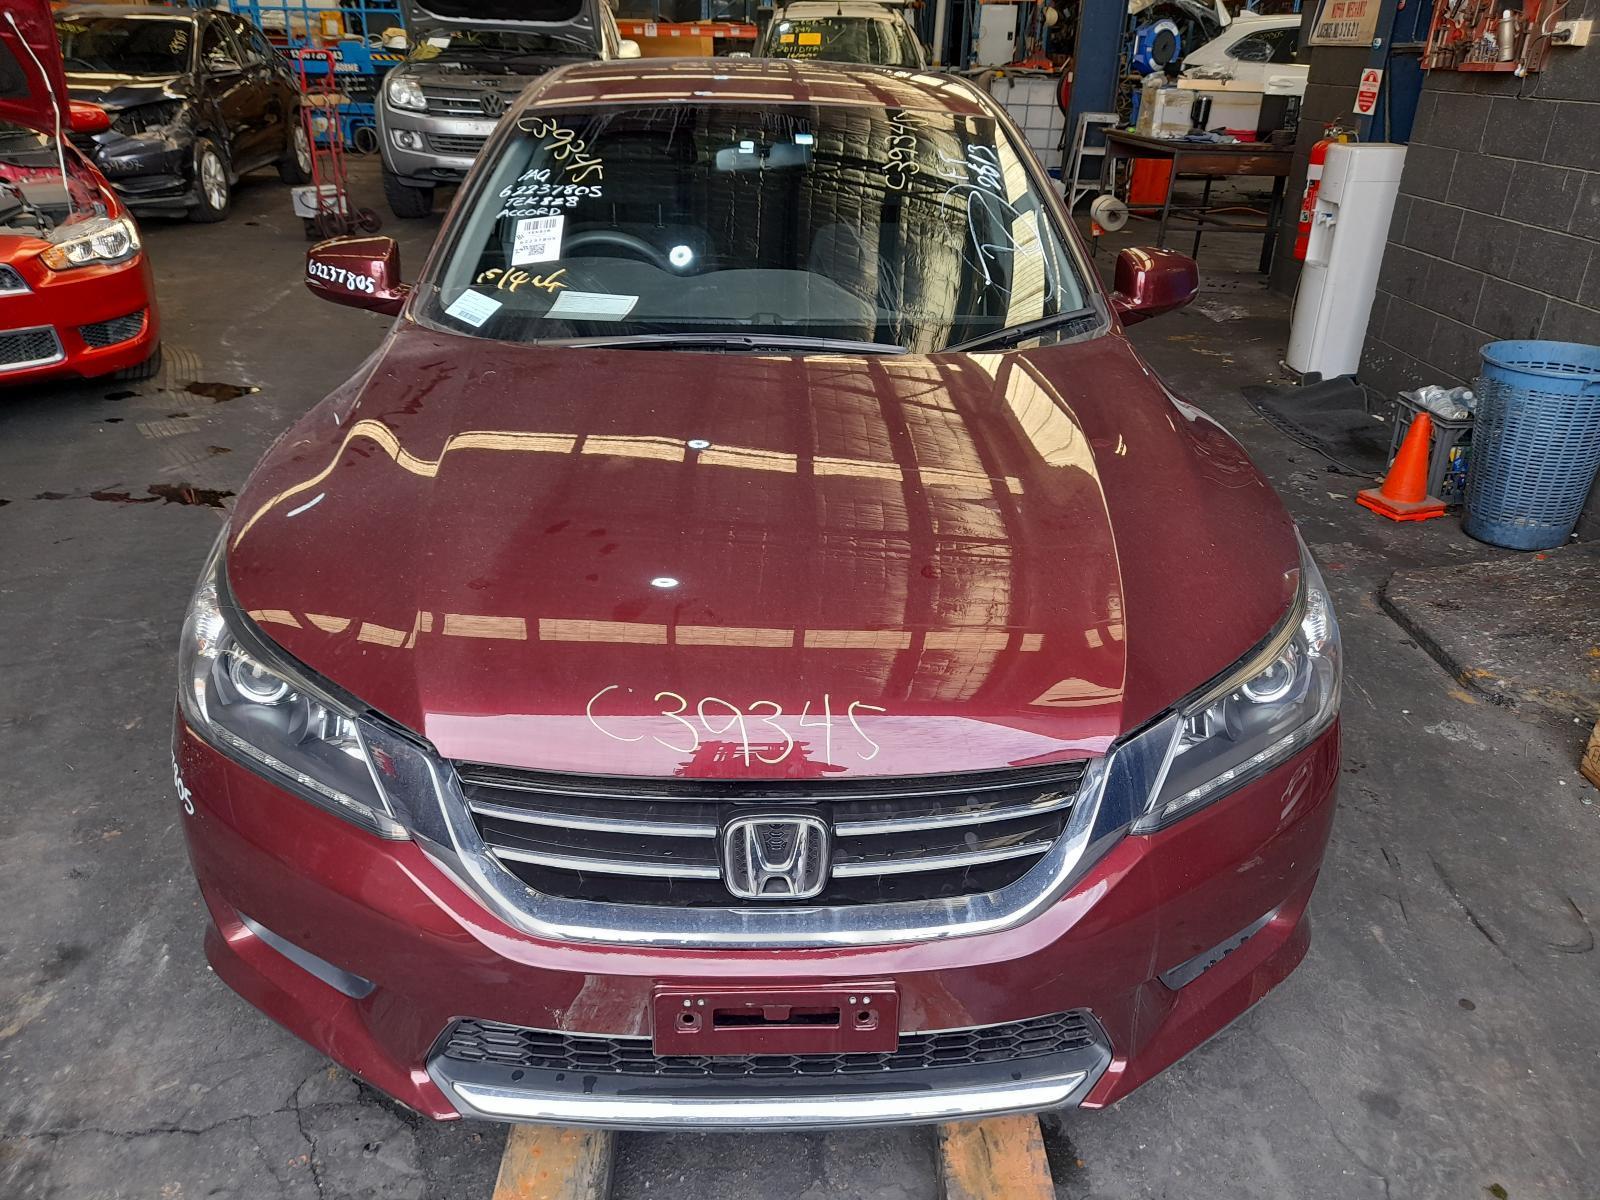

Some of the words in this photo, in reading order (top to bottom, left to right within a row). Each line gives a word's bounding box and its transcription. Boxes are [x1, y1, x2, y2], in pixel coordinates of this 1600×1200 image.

[517, 117, 603, 182] C39345
[499, 184, 602, 197] 62237805
[496, 207, 561, 219] ACCORD
[586, 684, 887, 768] C39345
